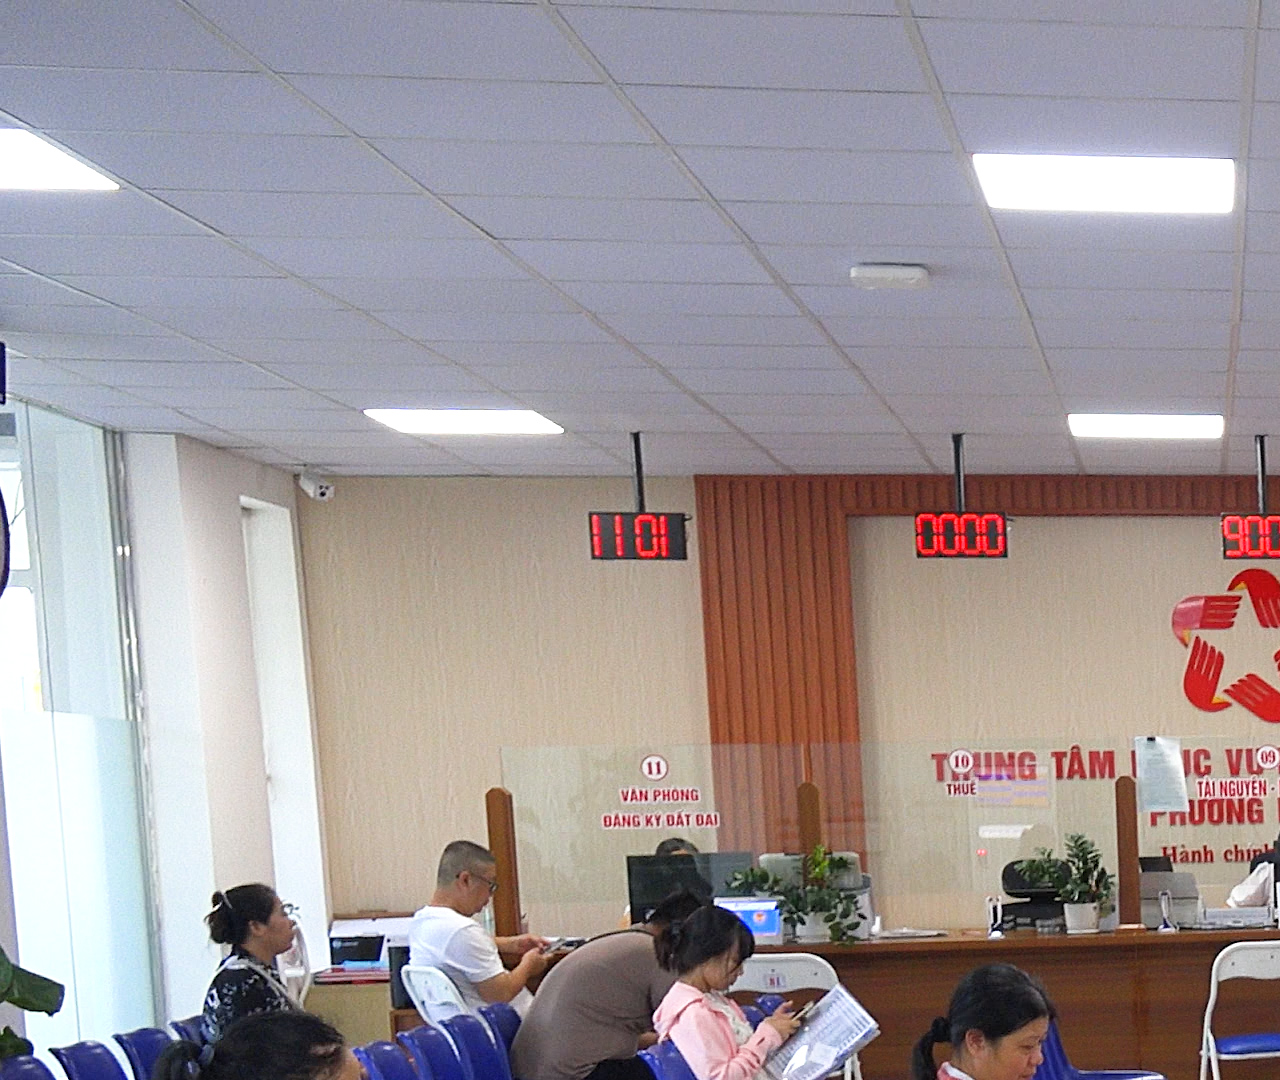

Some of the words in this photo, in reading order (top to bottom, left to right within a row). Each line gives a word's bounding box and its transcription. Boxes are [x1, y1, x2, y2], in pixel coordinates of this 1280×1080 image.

[590, 514, 669, 558] 1101
[916, 513, 1004, 556] 0000
[647, 761, 662, 776] 11
[954, 754, 970, 769] 10
[1050, 744, 1116, 780] TÂM
[1260, 751, 1276, 765] 09
[1197, 777, 1216, 798] TÀI
[1219, 775, 1267, 797] NGUYÊN
[1161, 843, 1215, 864] Hành
